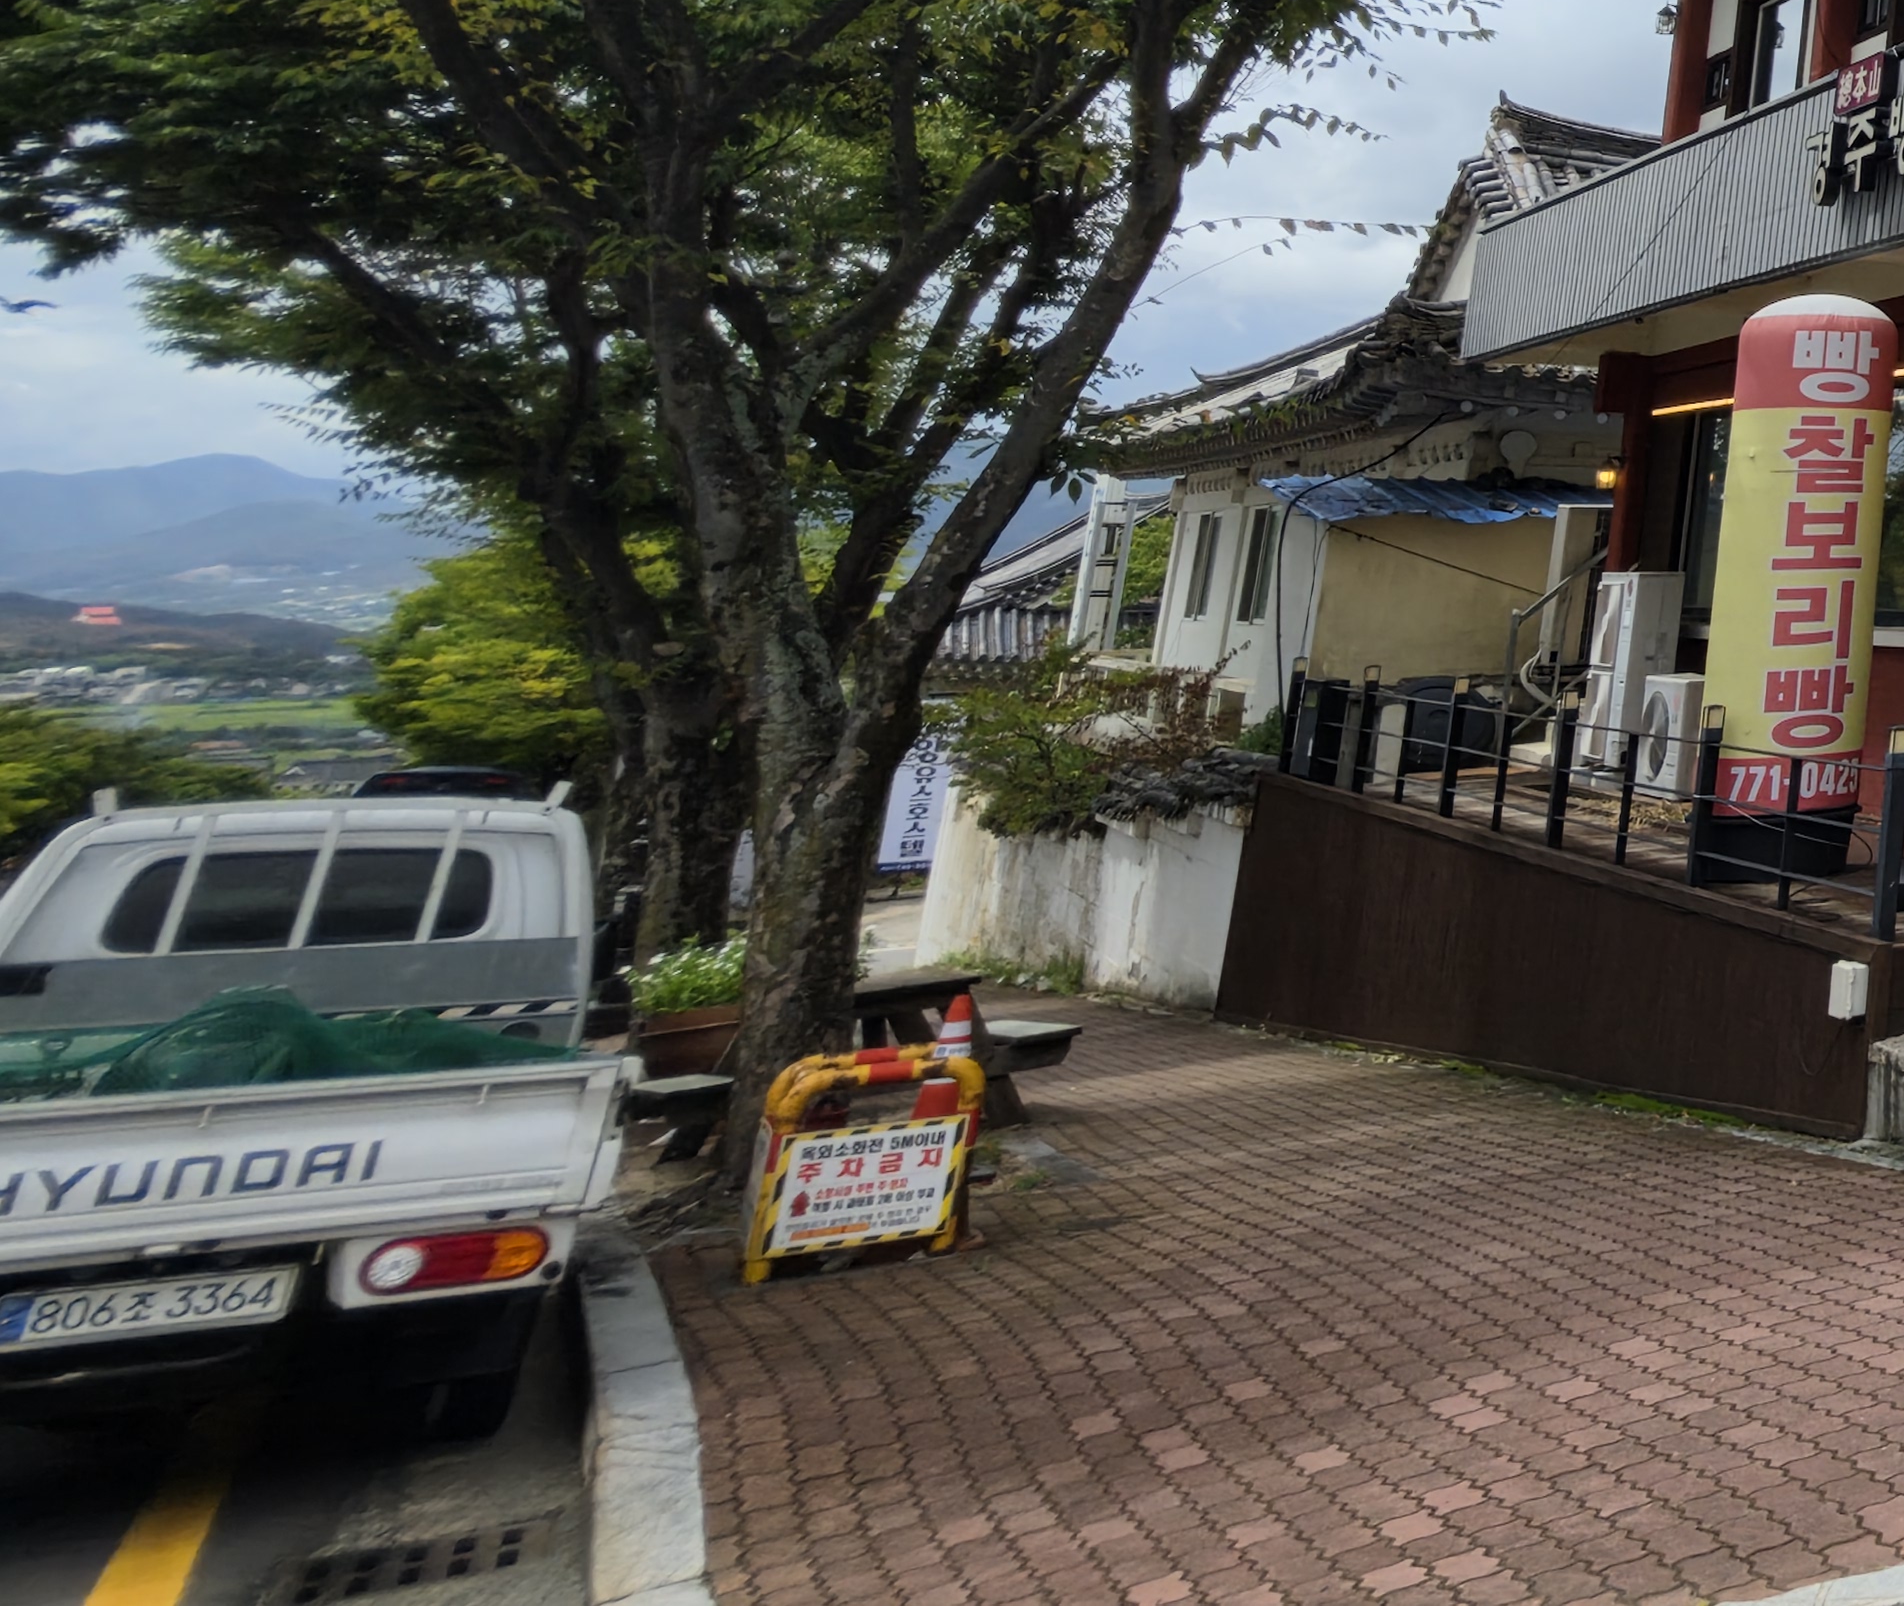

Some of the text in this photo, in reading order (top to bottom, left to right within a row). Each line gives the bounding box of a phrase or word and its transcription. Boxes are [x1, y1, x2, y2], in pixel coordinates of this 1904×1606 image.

[1792, 330, 1880, 404] 빵
[1763, 415, 1875, 749] 찰보리빵
[1730, 759, 1859, 804] 771-0425
[801, 1130, 947, 1162] 옥외소화전 5M이내
[30, 1277, 278, 1334] 806조 3364
